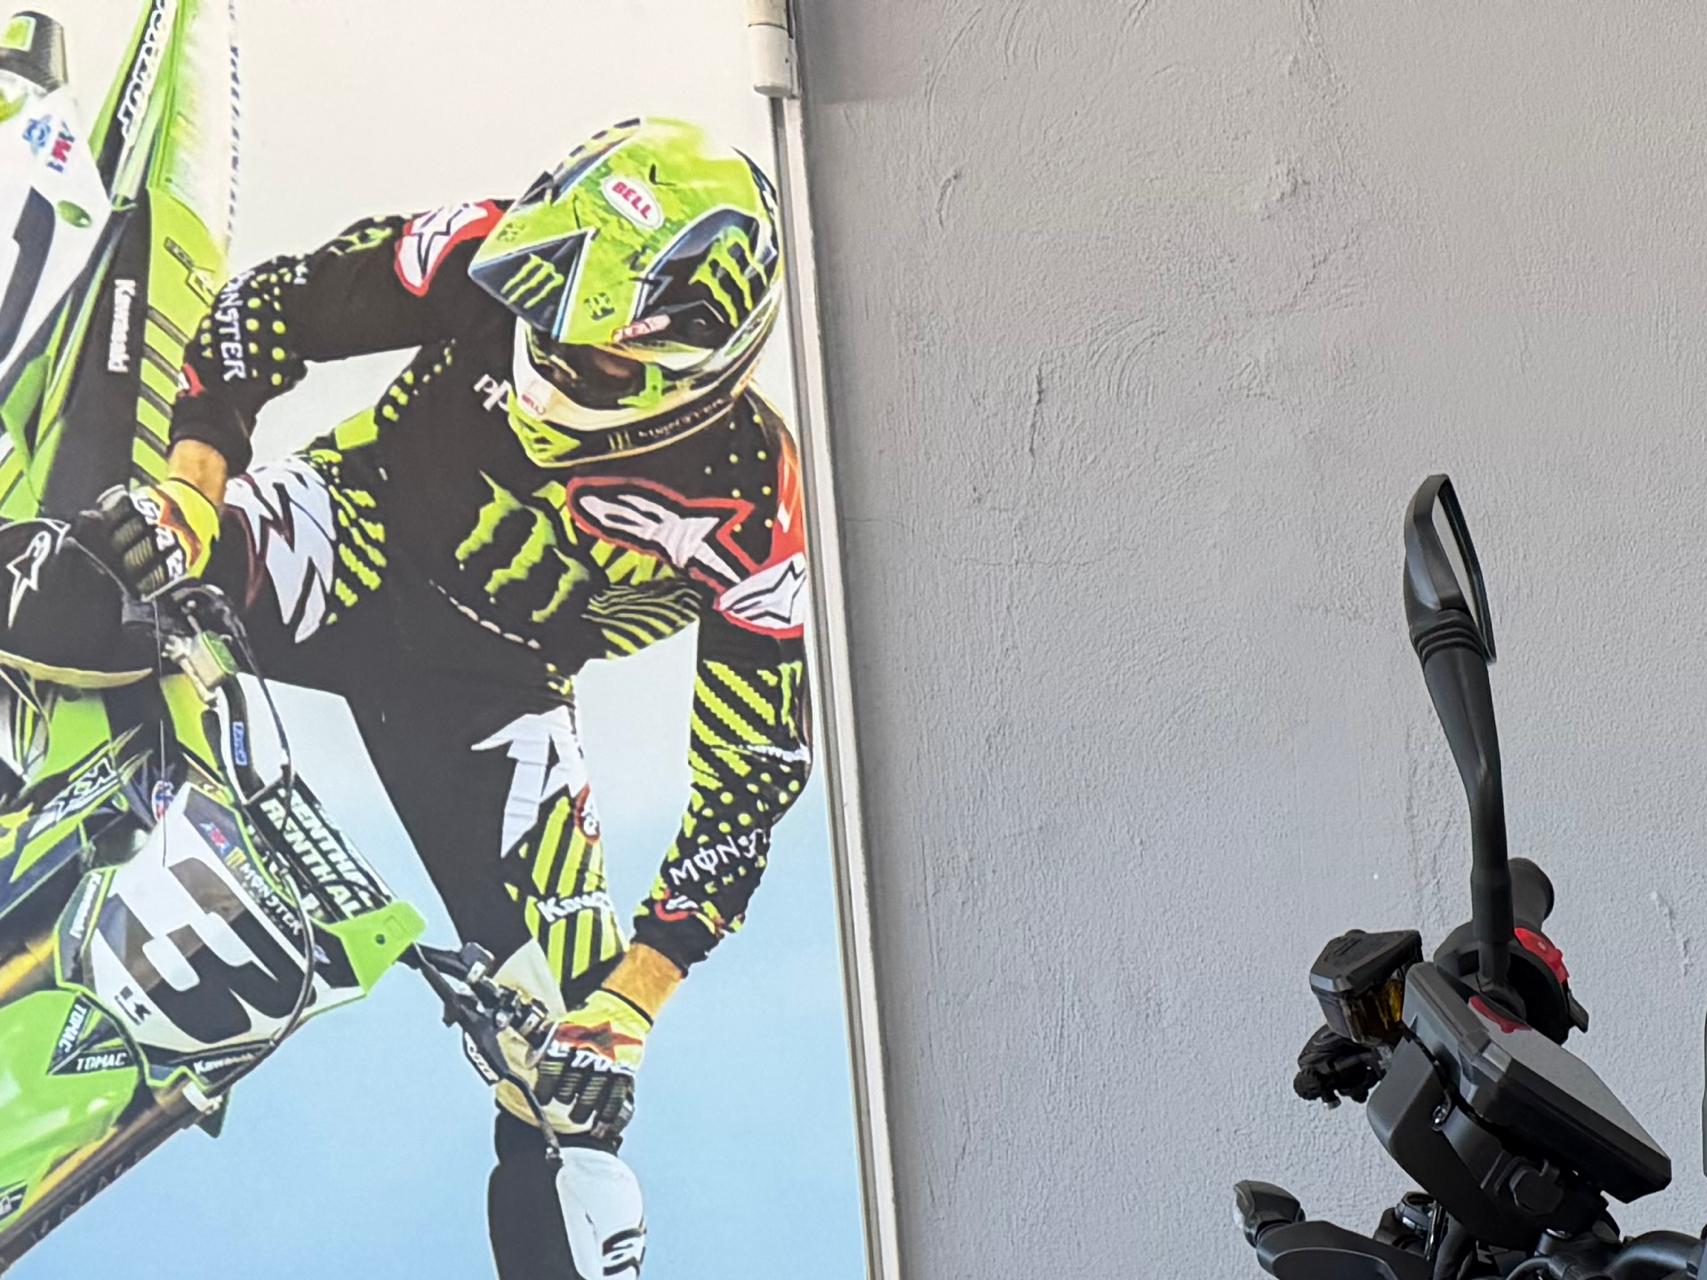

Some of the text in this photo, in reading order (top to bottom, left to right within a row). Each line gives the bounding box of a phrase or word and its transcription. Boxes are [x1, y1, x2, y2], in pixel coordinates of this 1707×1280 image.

[611, 181, 653, 221] BELL
[258, 797, 357, 921] RENTHAL
[58, 1003, 87, 1053] TOMAC
[76, 1052, 127, 1072] TOMAC
